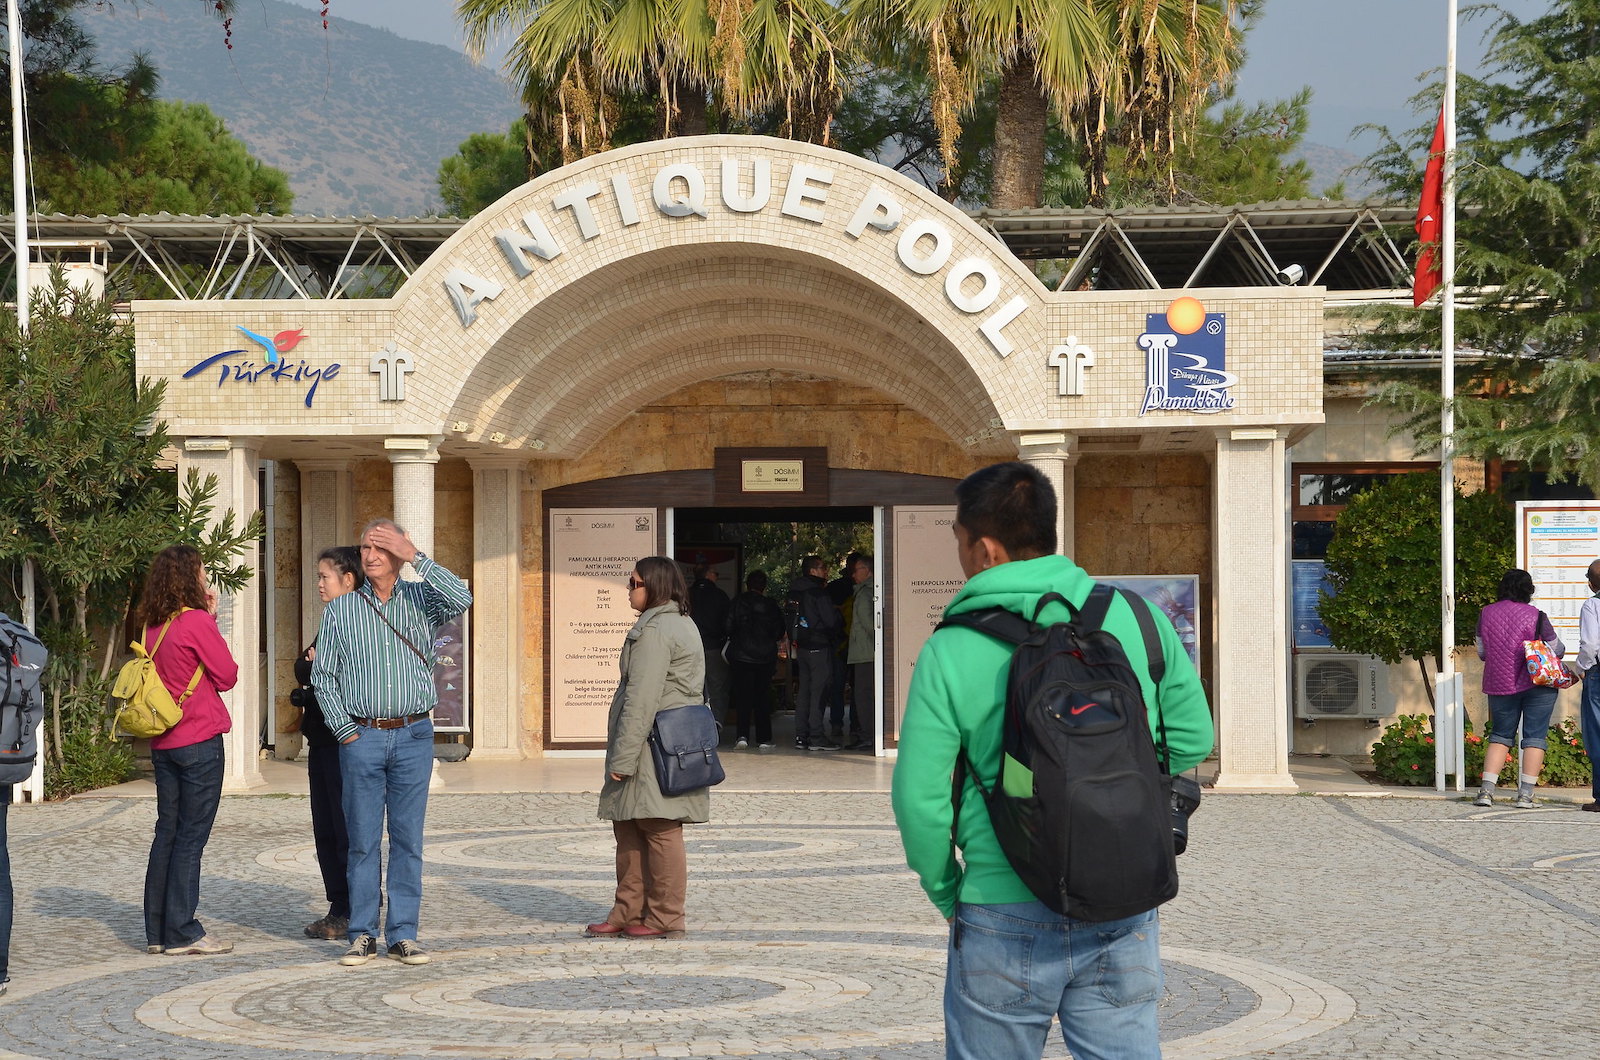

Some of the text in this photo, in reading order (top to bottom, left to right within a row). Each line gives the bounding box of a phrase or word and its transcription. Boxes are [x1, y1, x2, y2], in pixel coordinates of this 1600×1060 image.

[443, 156, 1029, 358] ANTIQUE POOL
[182, 349, 341, 408] Türkiye
[1139, 386, 1235, 417] Pamukkale
